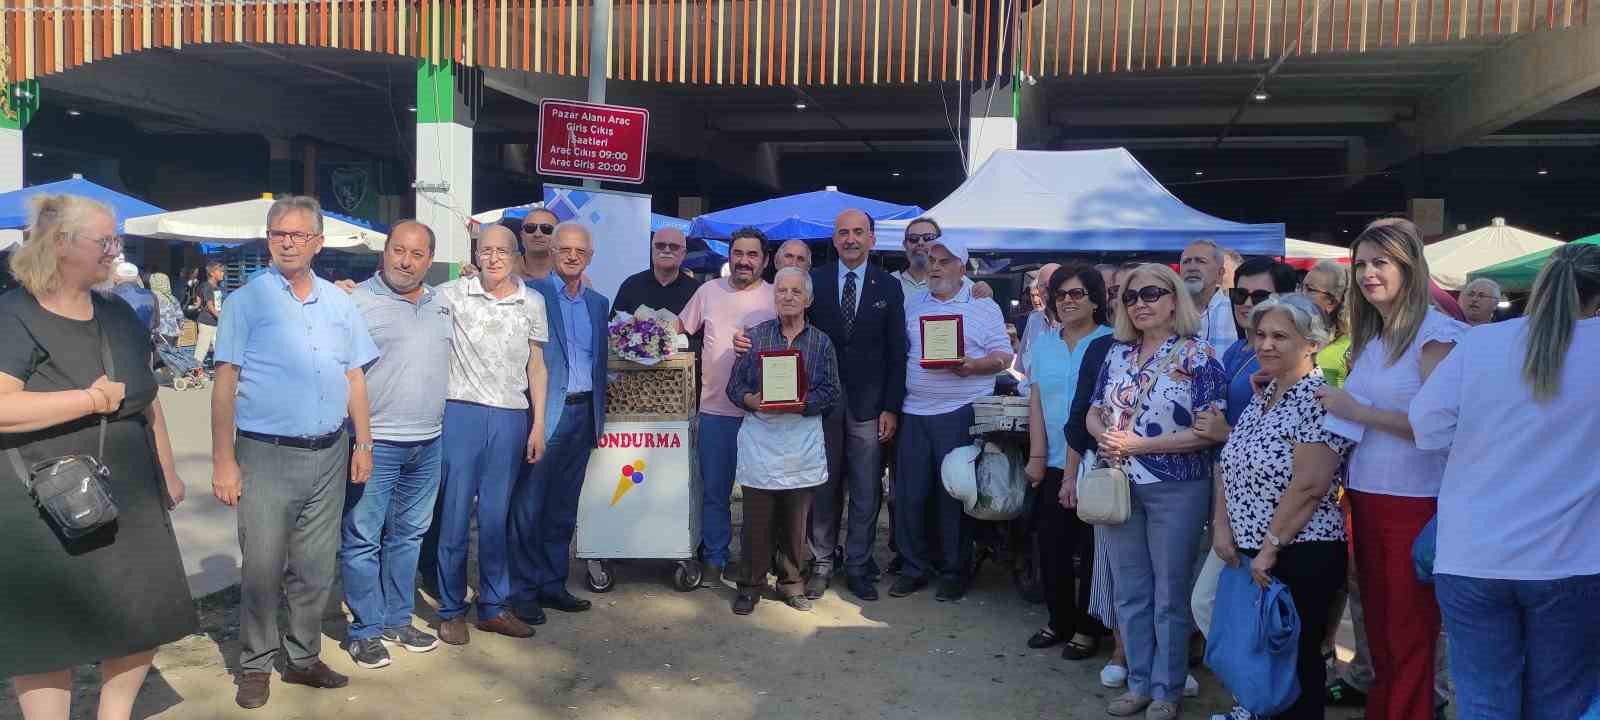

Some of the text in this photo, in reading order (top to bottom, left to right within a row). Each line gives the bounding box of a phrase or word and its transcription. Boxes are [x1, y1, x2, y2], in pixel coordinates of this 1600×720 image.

[552, 108, 578, 119] Pazar
[581, 112, 606, 122] Alanı
[571, 135, 608, 147] Saatleri
[599, 150, 628, 161] 09:00
[598, 162, 626, 173] 20:00
[597, 432, 681, 449] ONDURMA
